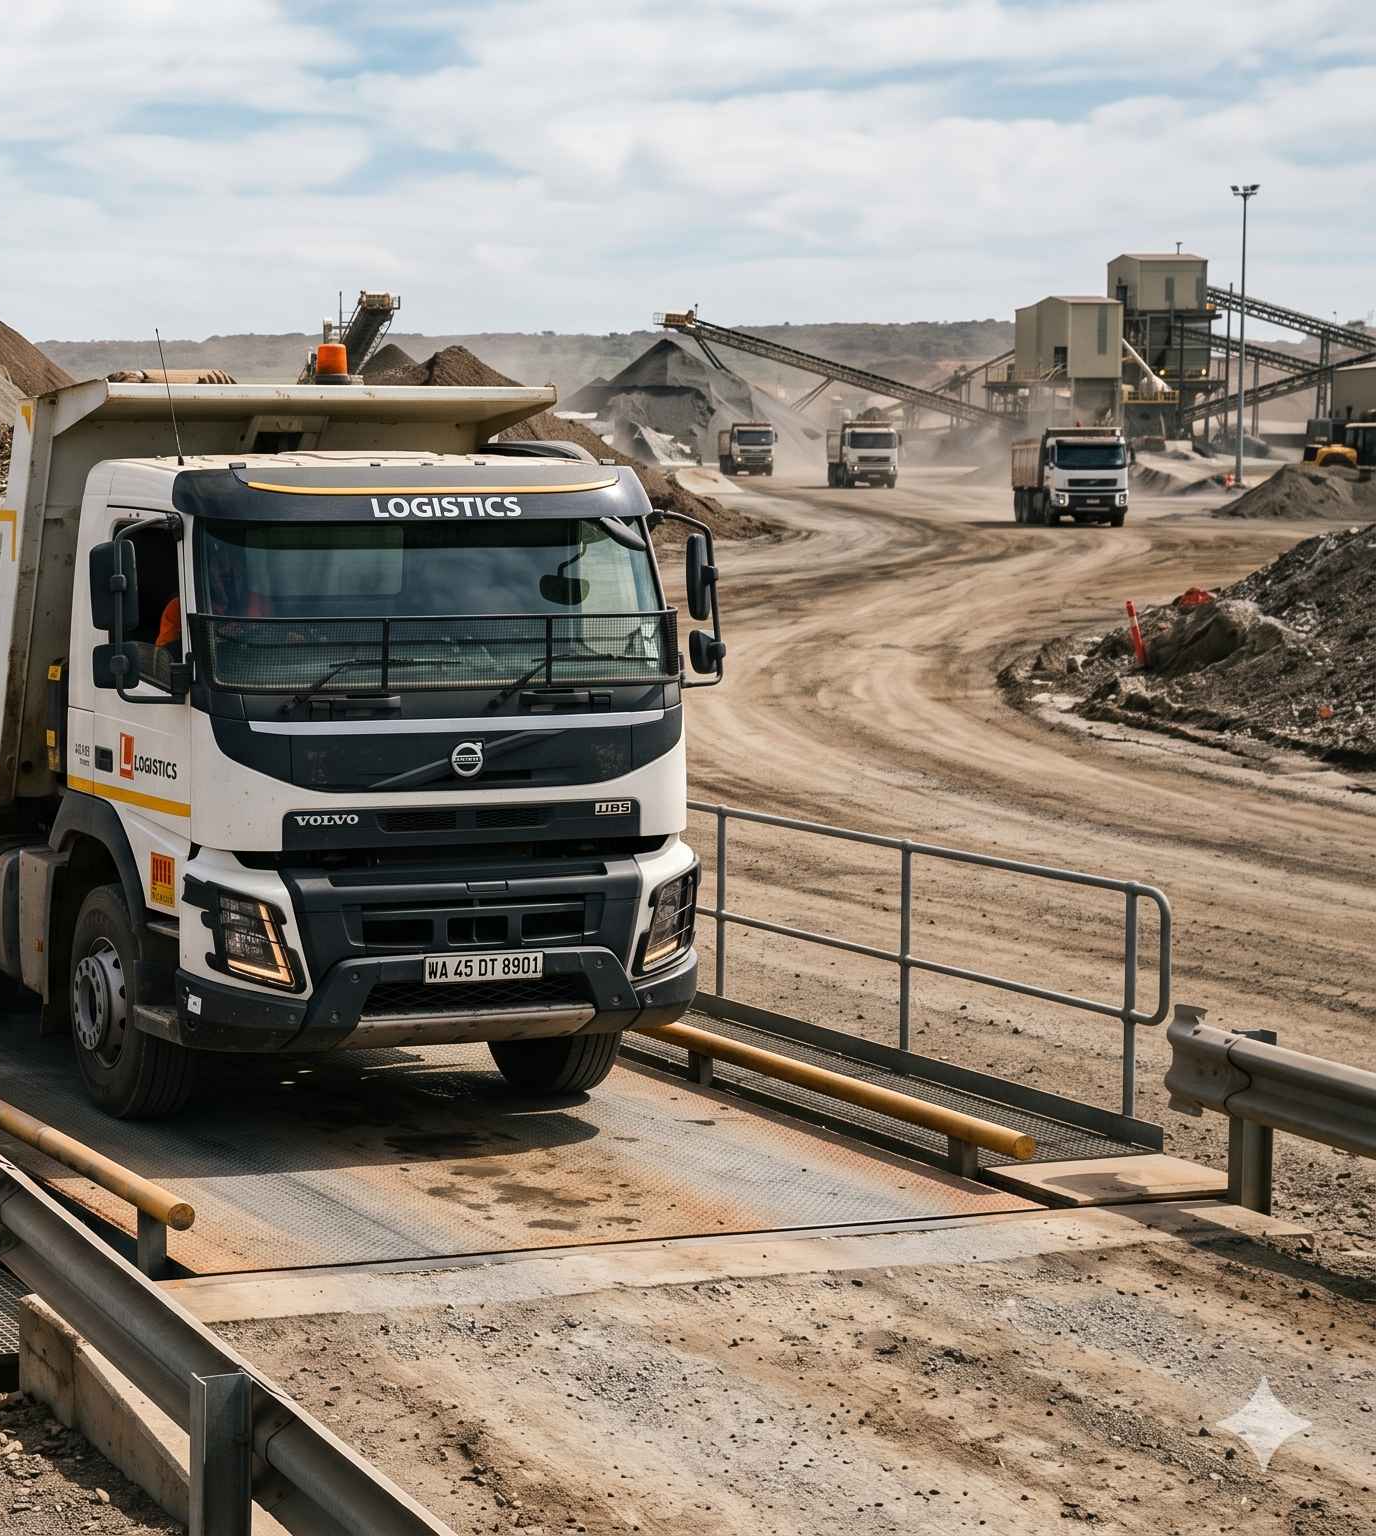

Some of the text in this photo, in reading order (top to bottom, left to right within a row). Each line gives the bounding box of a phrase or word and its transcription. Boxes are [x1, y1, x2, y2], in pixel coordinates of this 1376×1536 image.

[370, 496, 522, 518] LOGISTICS
[134, 754, 177, 780] LOGISTICS
[293, 814, 359, 826] VOLVO
[428, 956, 538, 979] WA 45 DT 8901
